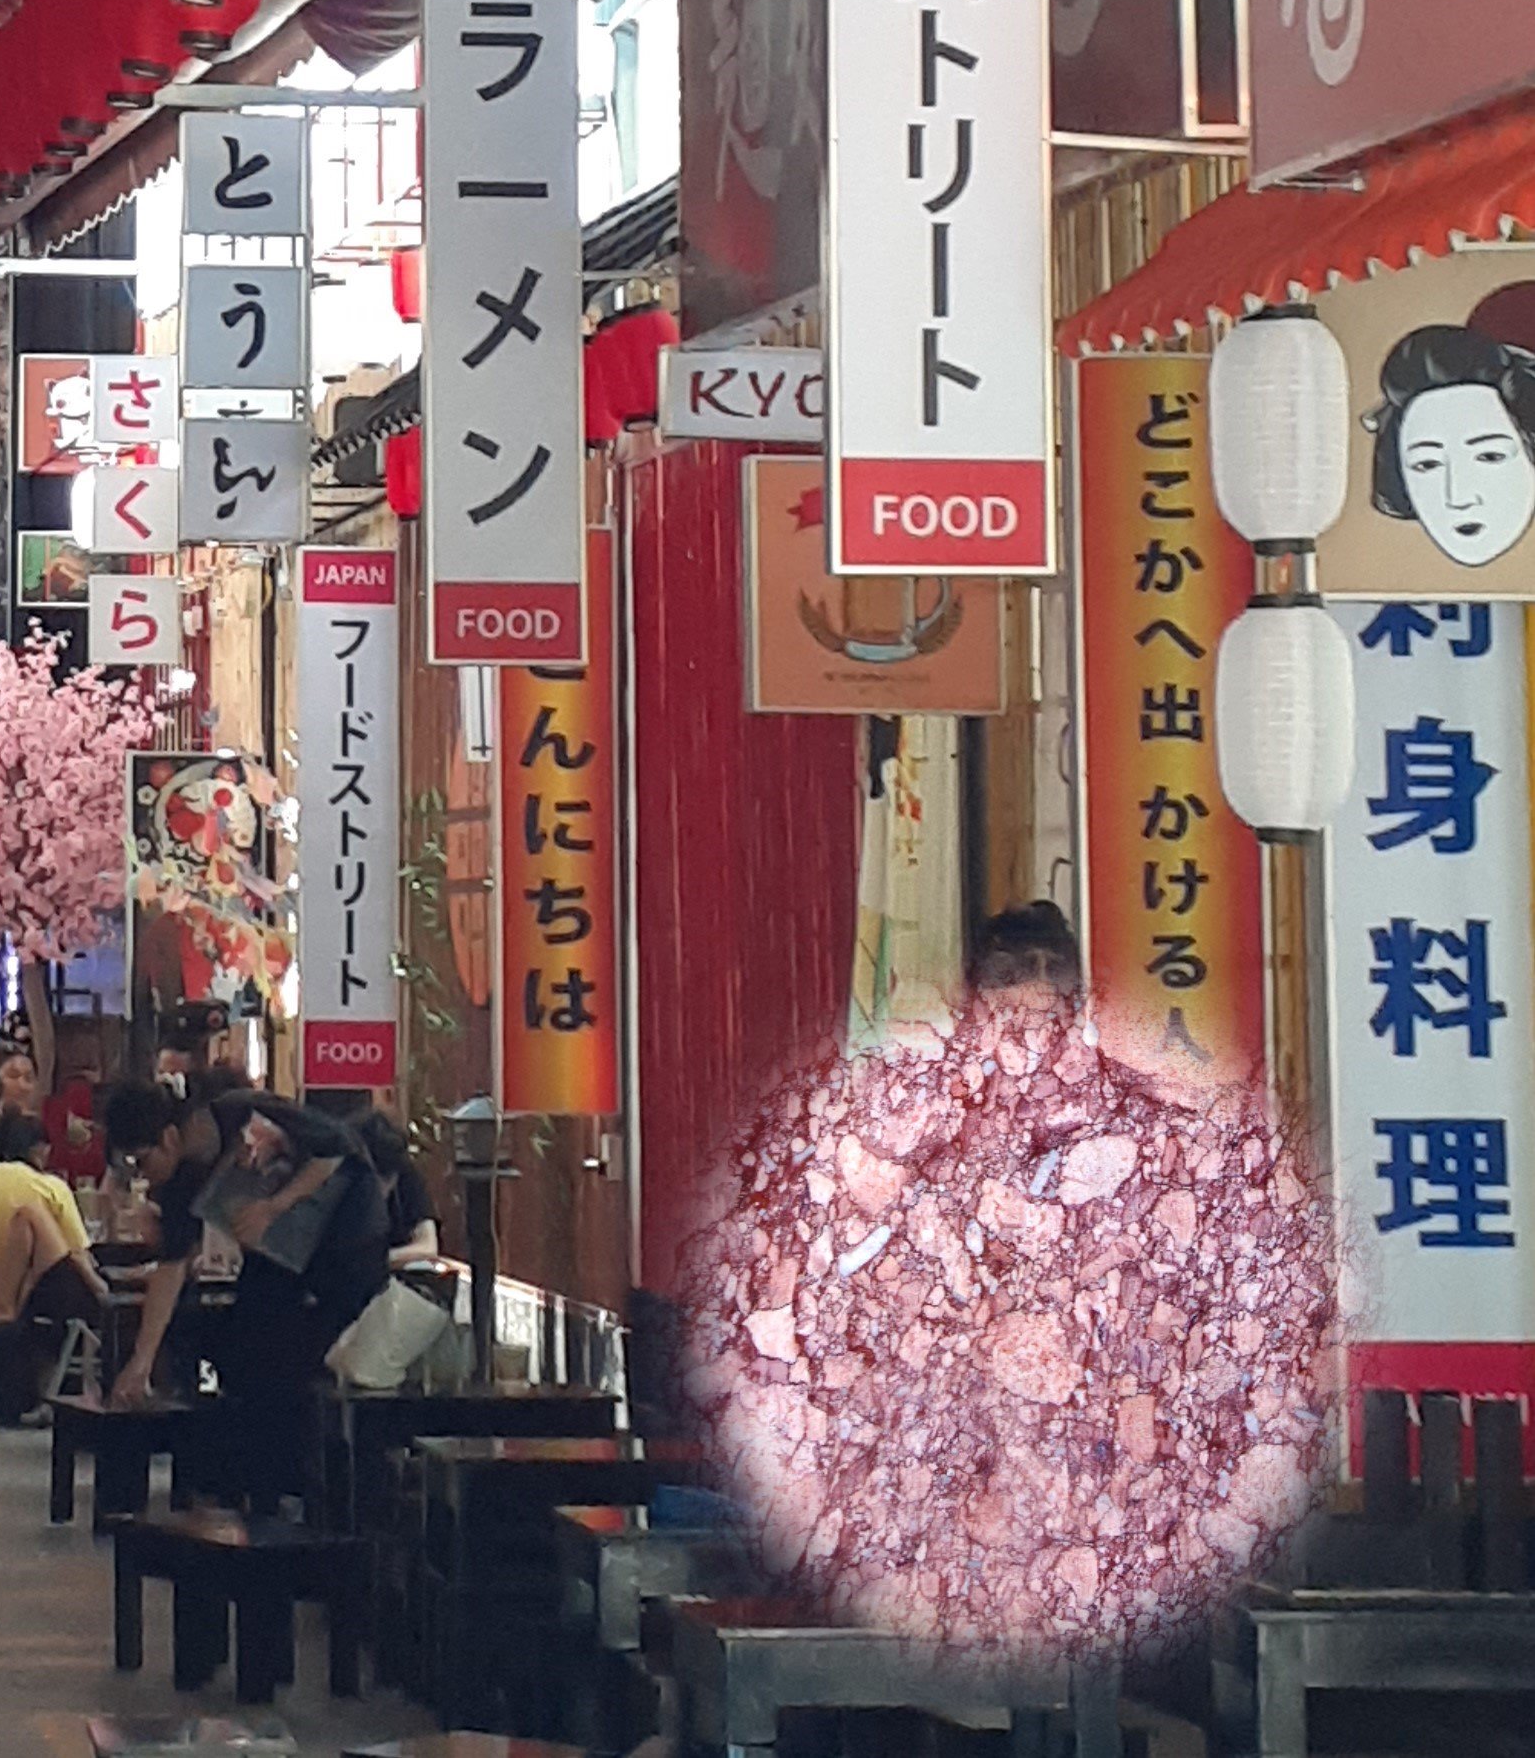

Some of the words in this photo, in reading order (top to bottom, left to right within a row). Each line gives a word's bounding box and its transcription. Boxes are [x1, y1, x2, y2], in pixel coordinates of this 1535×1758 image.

[458, 1, 552, 526] ラーメン
[107, 369, 160, 650] さくら
[871, 492, 1020, 540] FOOD
[313, 562, 388, 586] JAPAN
[456, 606, 562, 642] FOOD
[328, 618, 375, 1008] フードストリート
[315, 1041, 384, 1065] FOOD
